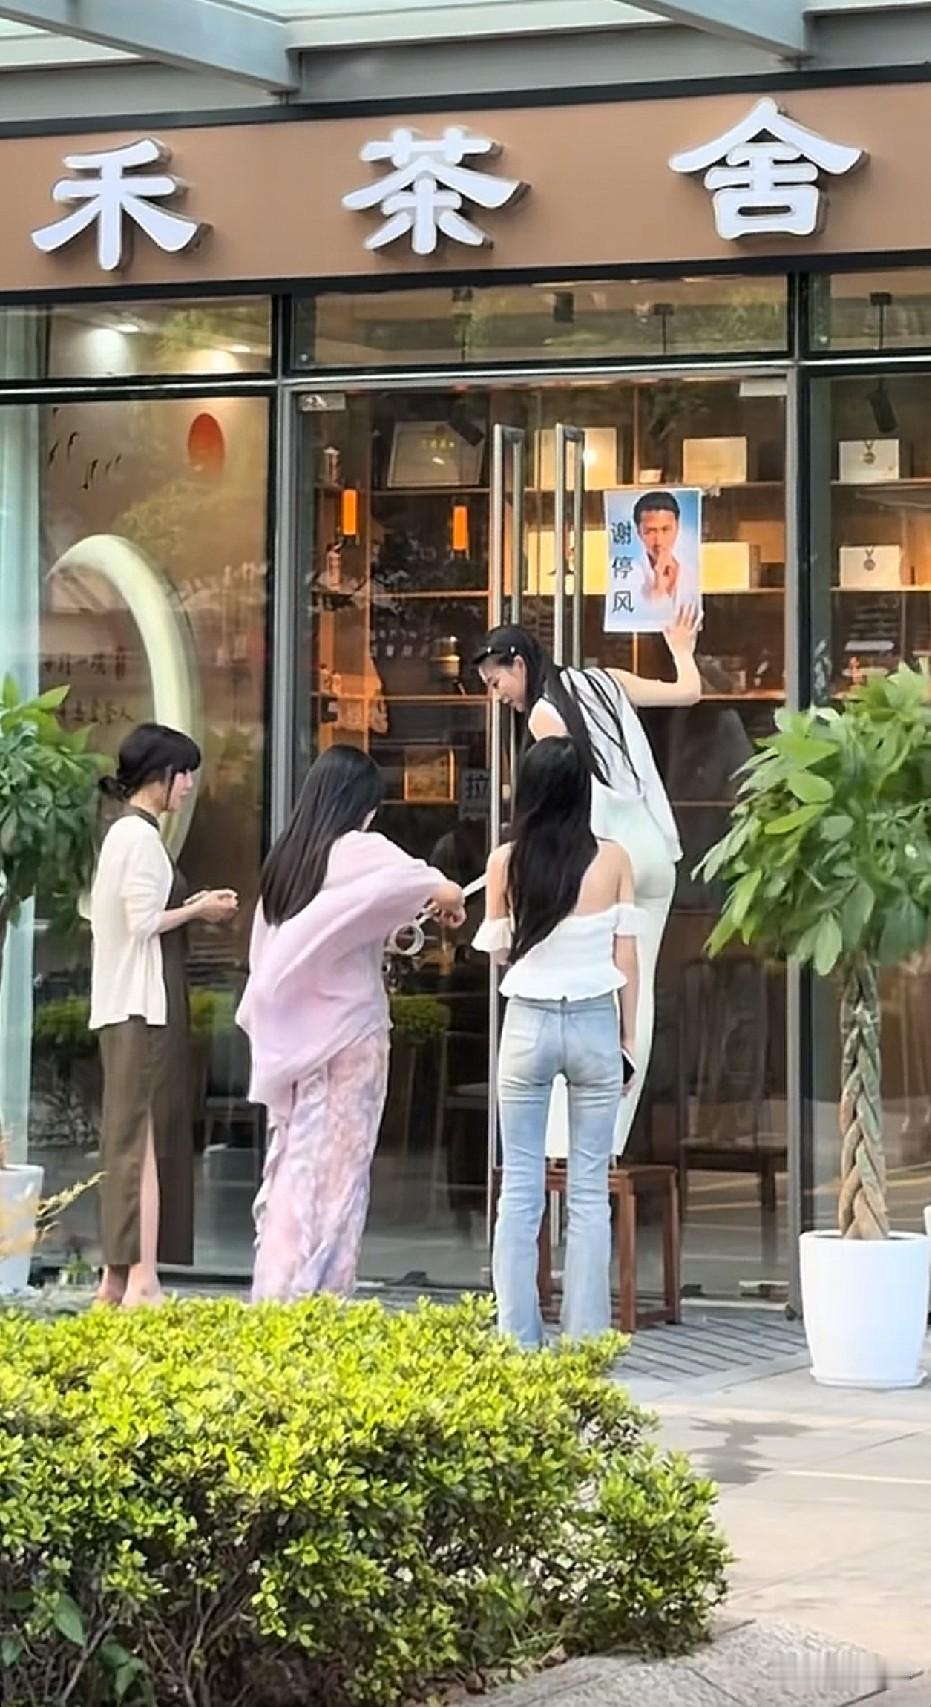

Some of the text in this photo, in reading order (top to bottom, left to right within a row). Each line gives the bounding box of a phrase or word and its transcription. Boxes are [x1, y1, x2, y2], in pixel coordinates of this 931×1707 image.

[30, 96, 866, 271] 禾茶舍
[611, 520, 634, 613] 谢停风
